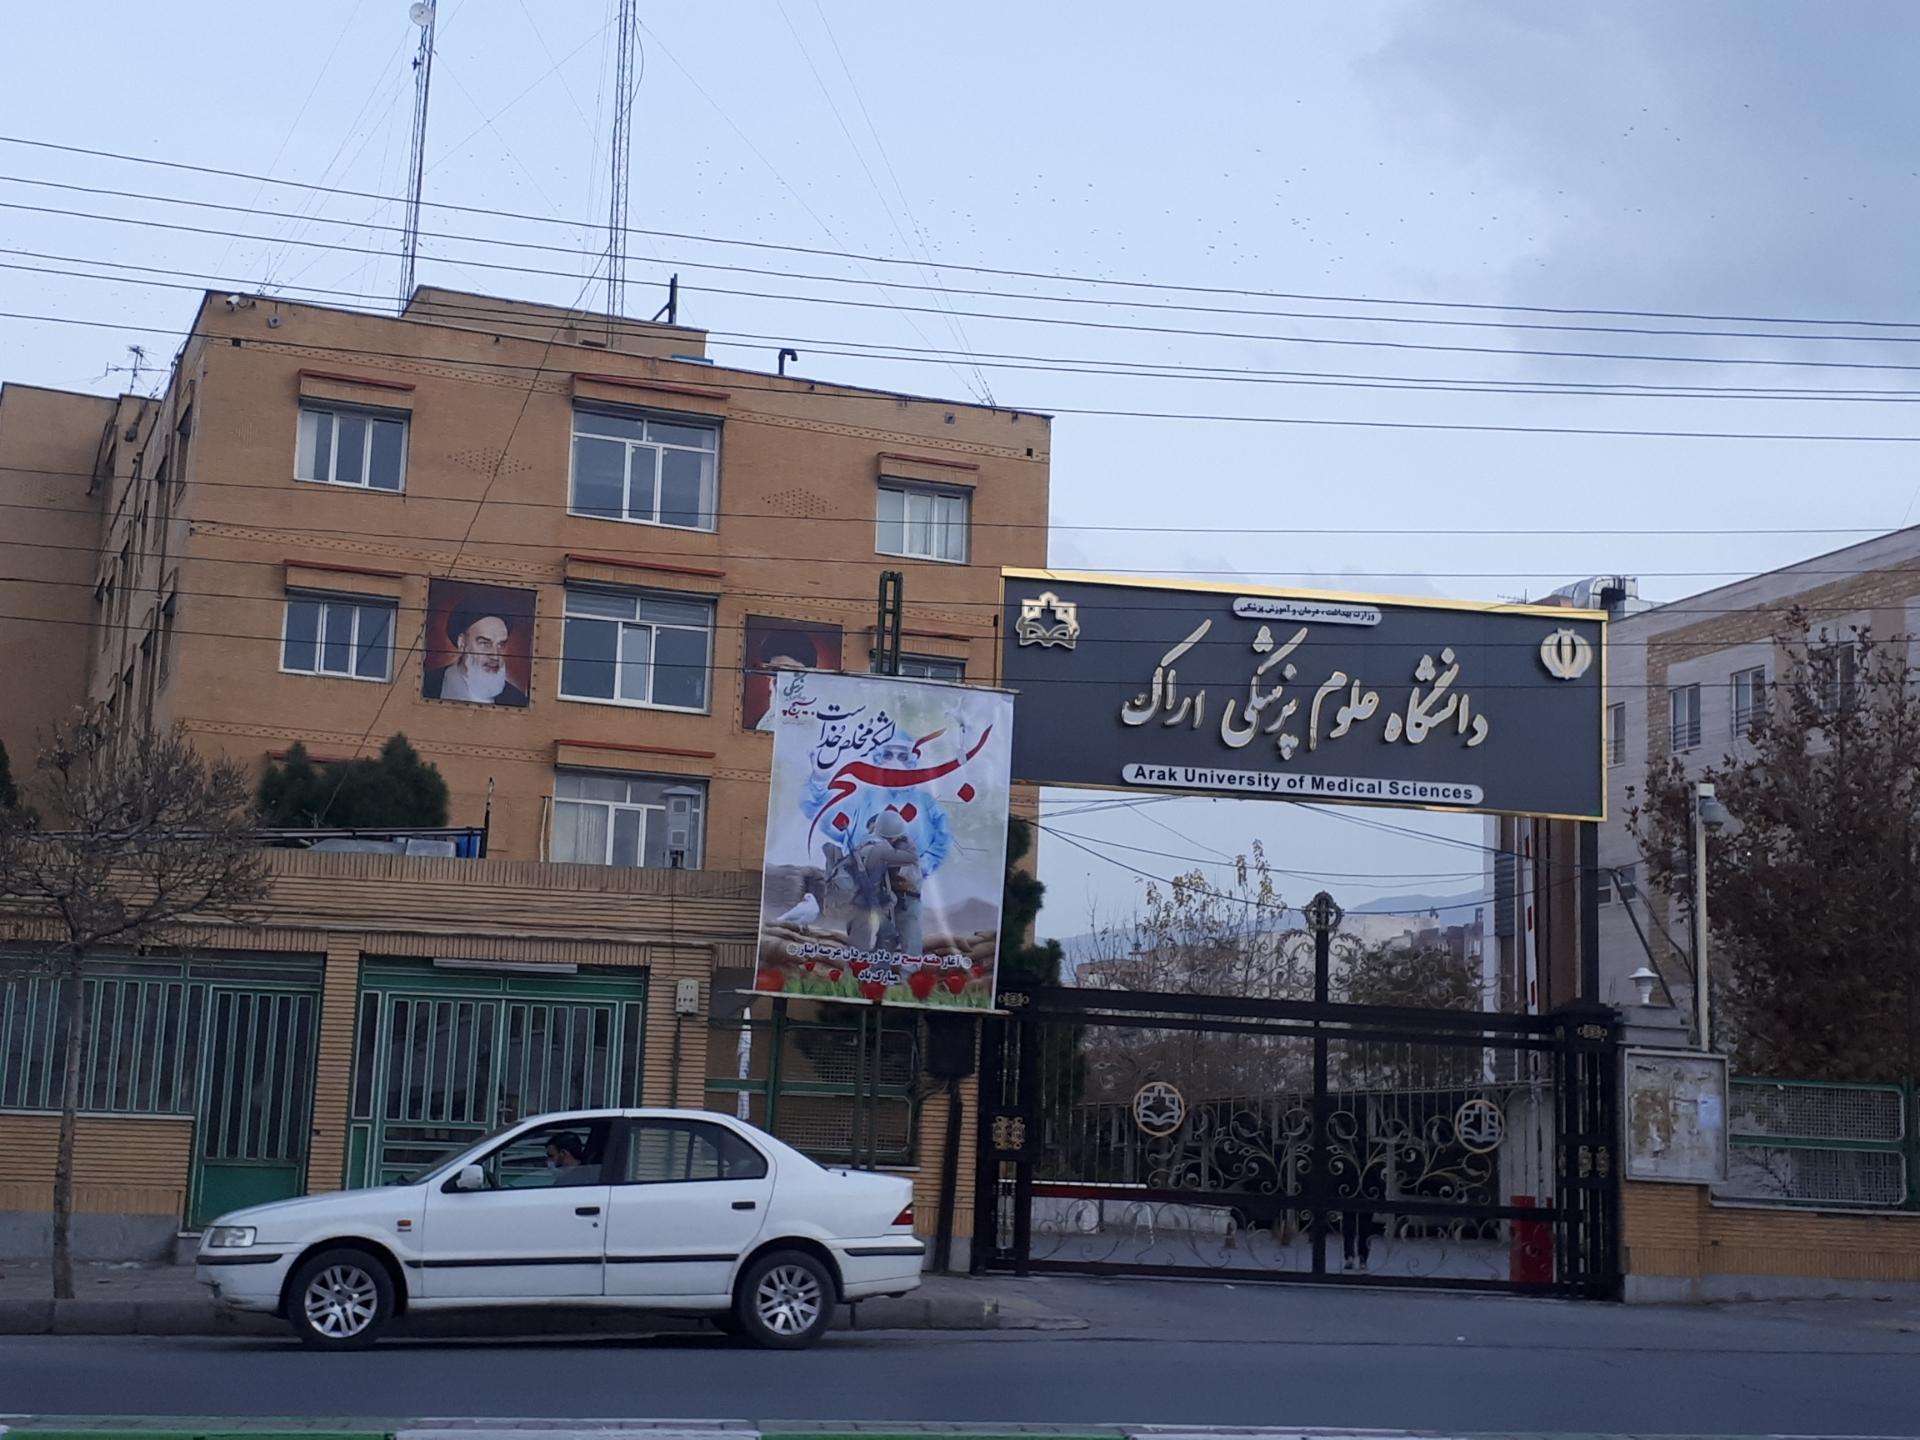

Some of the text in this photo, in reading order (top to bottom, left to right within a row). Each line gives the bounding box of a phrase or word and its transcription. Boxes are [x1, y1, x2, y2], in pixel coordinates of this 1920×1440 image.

[1240, 602, 1264, 613] پزشکی
[1265, 604, 1290, 615] آموزش
[1300, 607, 1320, 617] درمان
[1353, 611, 1375, 621] وزارت
[1121, 618, 1489, 761] دانشگاه علوم پزشکی اراک
[860, 710, 896, 758] لشکر
[808, 724, 993, 858] بسیج
[1134, 765, 1473, 800] Arak University of Medical Sciences
